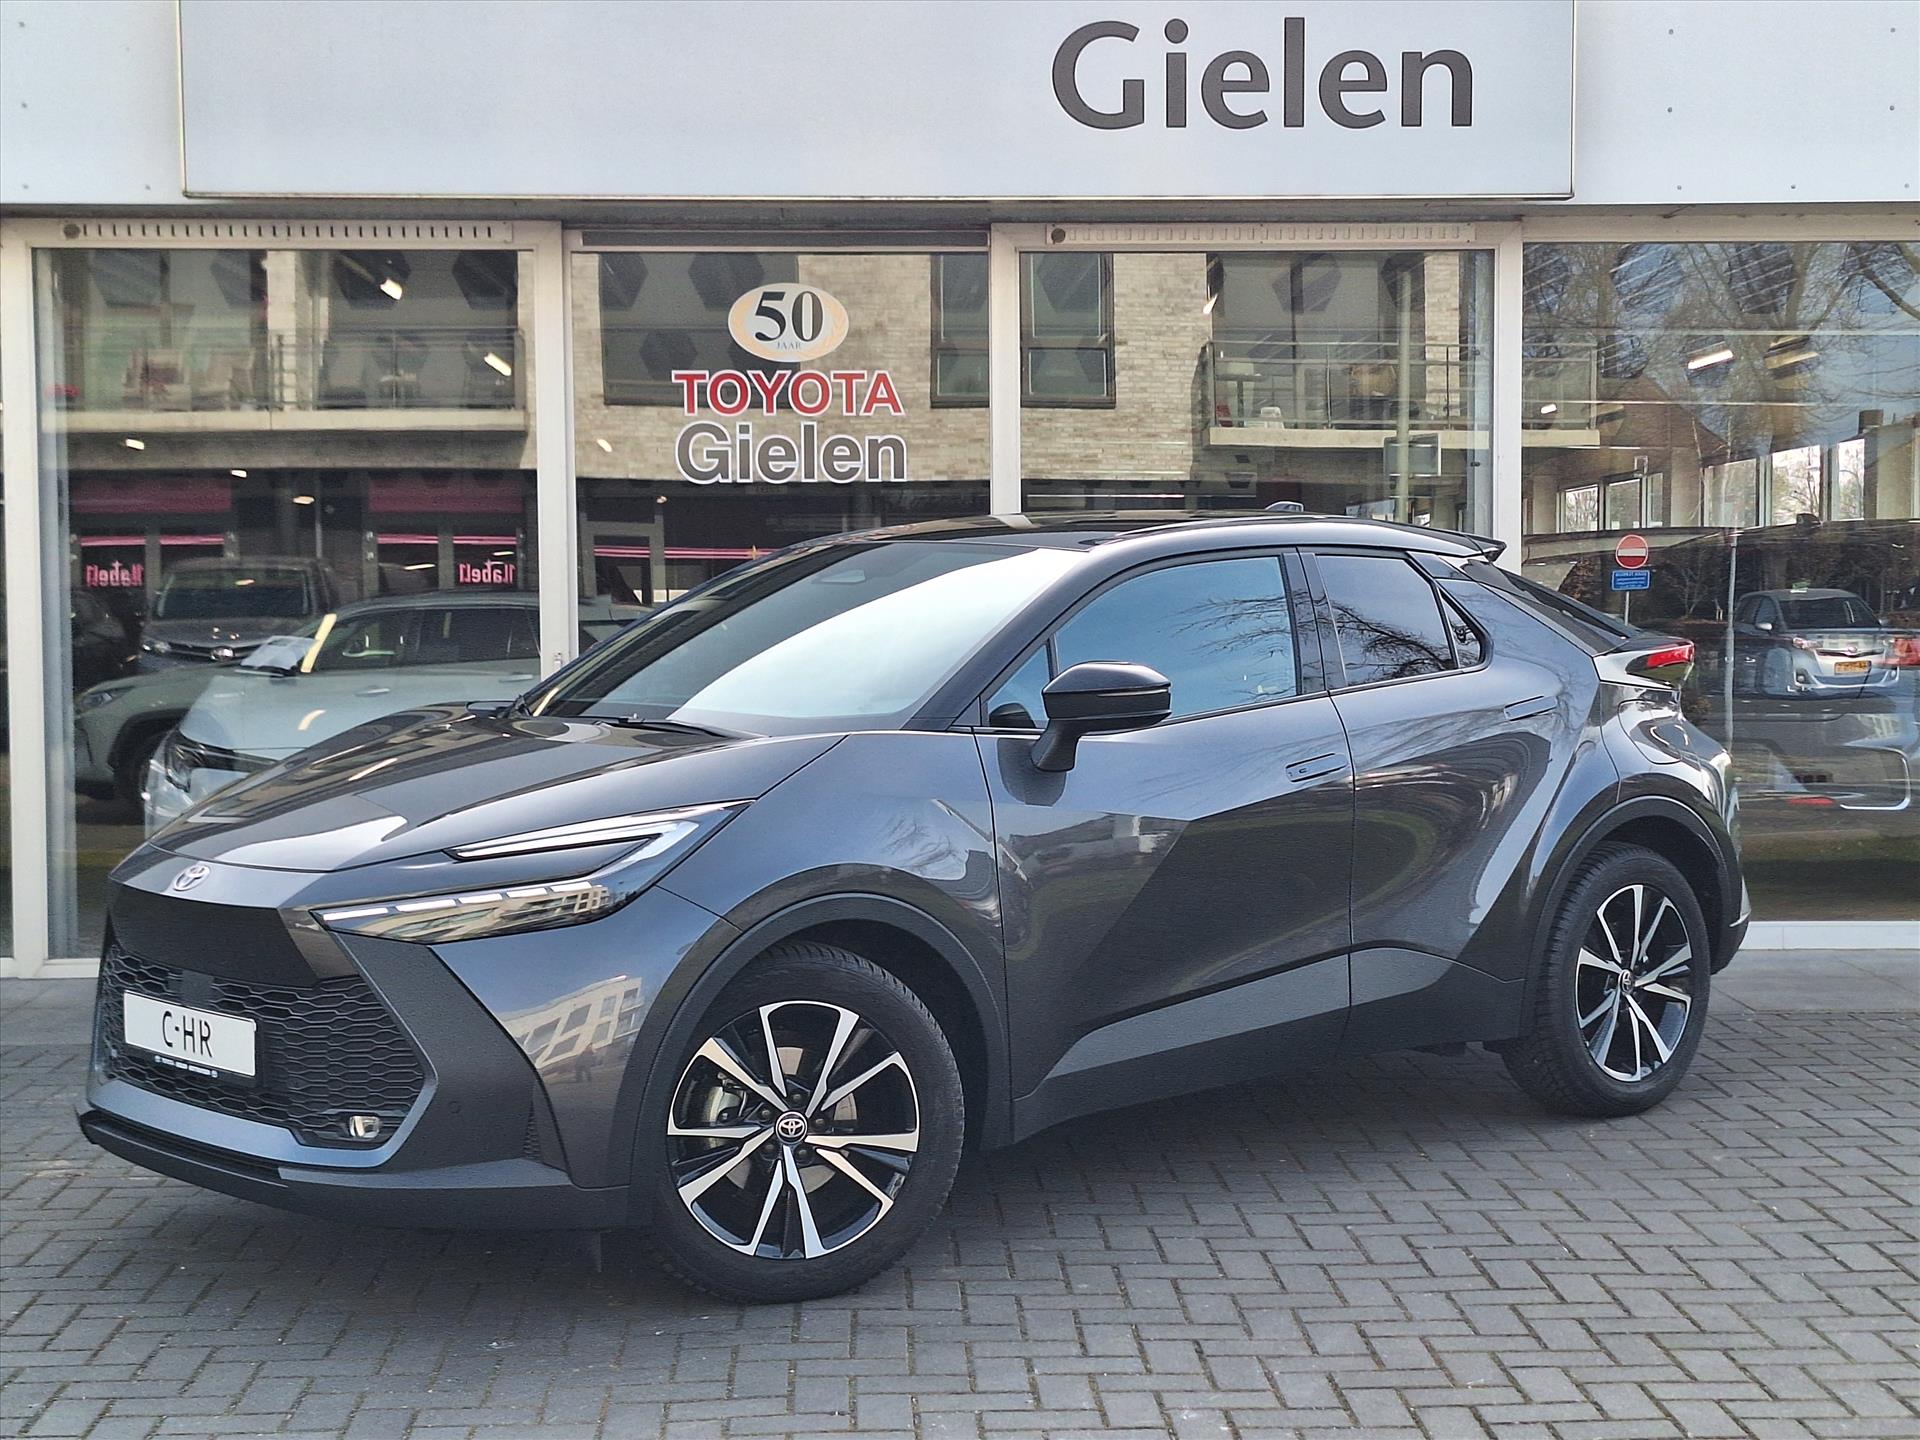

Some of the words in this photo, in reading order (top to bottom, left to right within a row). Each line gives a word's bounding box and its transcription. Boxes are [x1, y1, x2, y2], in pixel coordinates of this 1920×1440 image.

[1052, 17, 1473, 130] Gielen
[755, 291, 824, 342] 50
[776, 341, 804, 351] JAAR
[672, 370, 905, 416] TOYOTA
[675, 420, 907, 484] Gielen
[162, 1010, 213, 1058] C-HR
